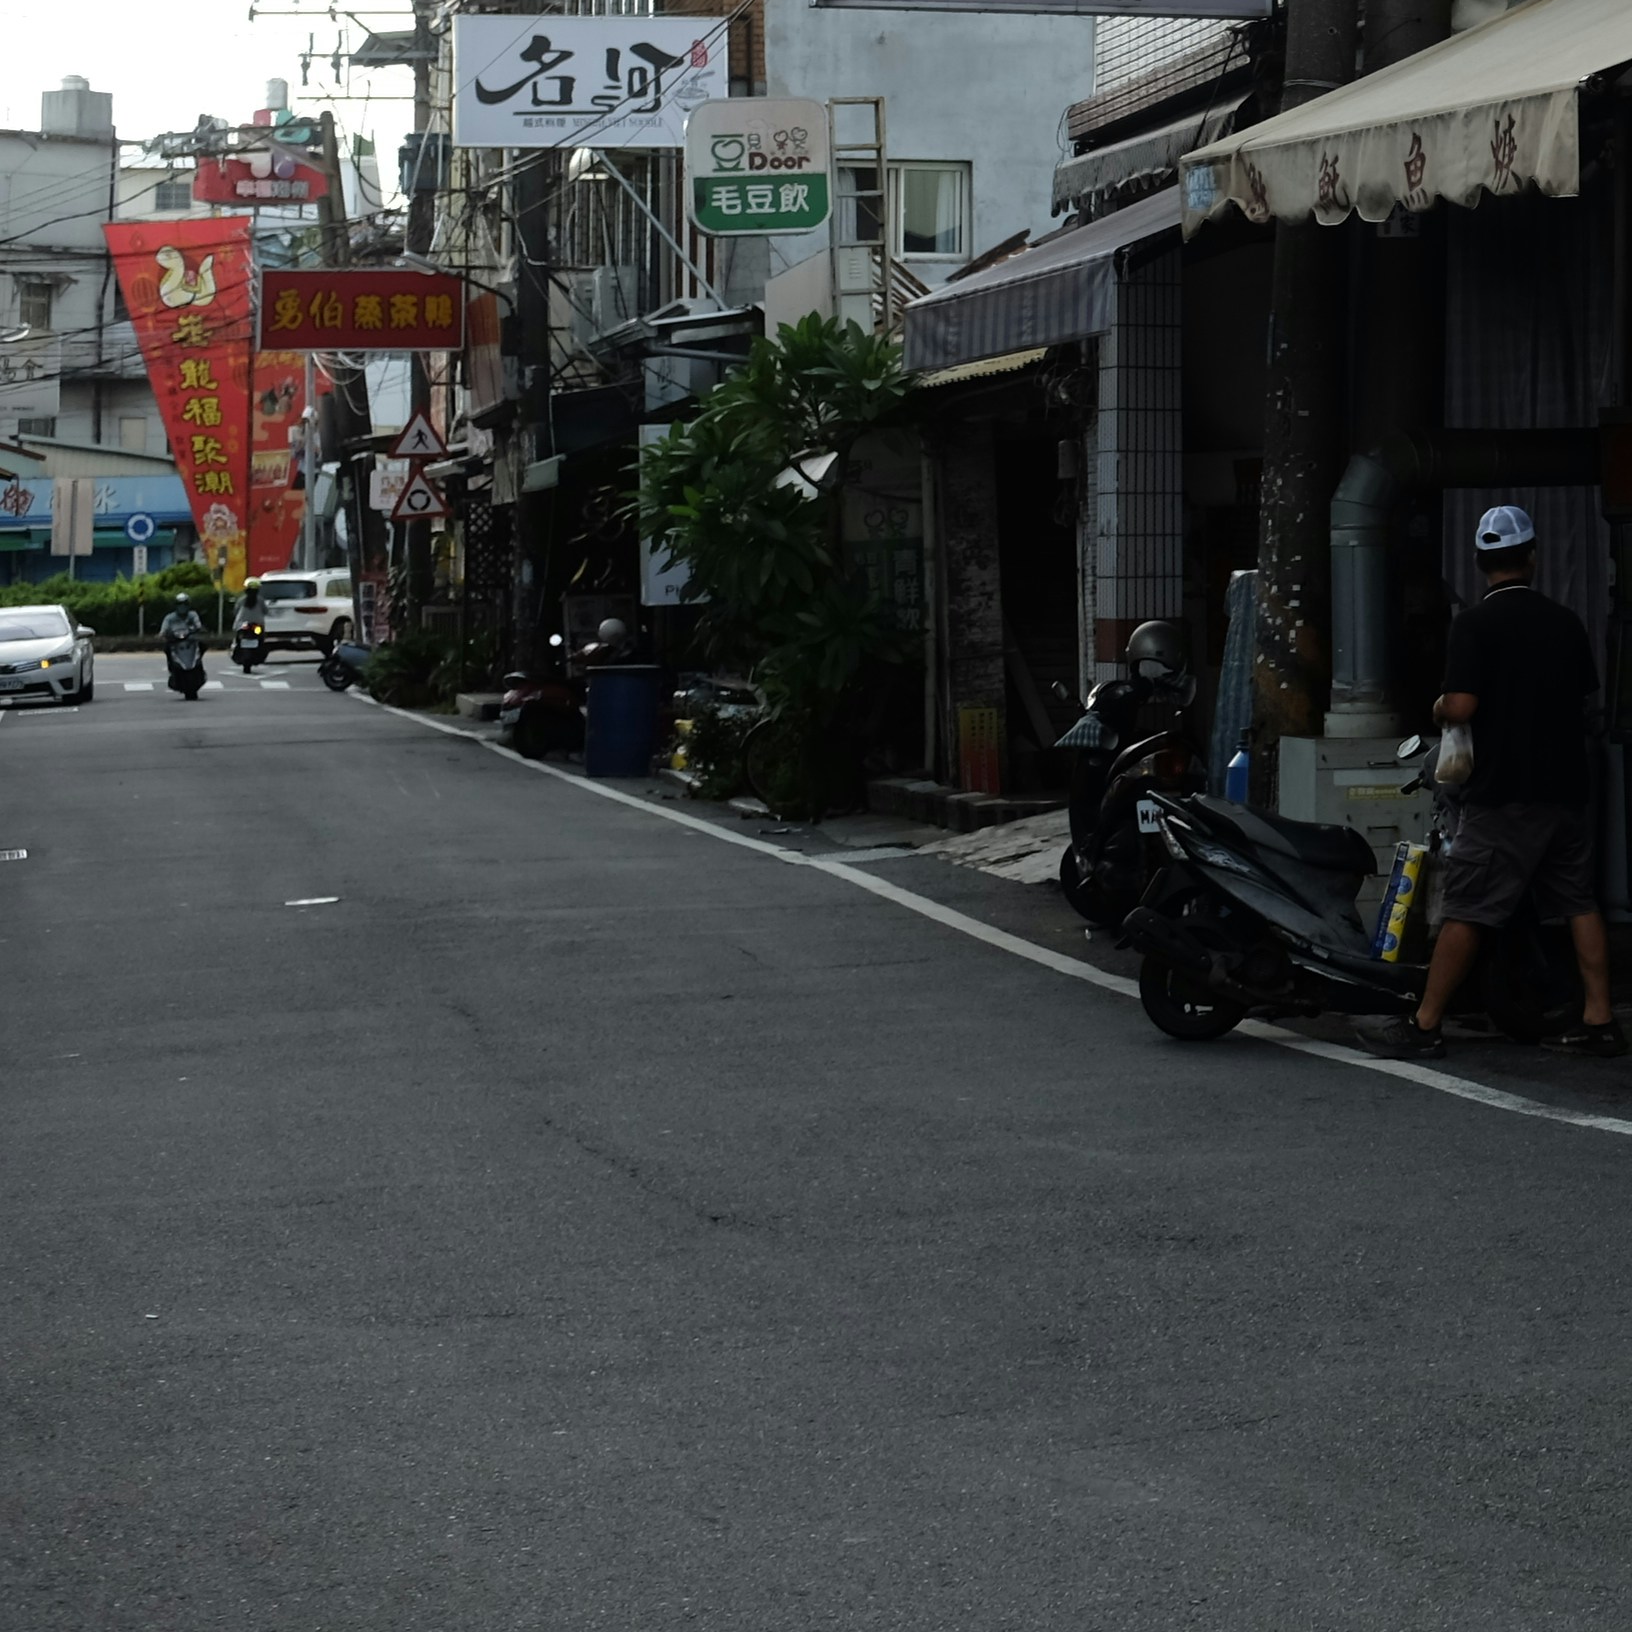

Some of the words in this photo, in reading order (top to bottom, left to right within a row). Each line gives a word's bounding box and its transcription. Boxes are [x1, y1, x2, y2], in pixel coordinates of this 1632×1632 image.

[749, 152, 810, 170] Door
[711, 183, 810, 215] 毛豆飲
[268, 288, 344, 332] 勇伯
